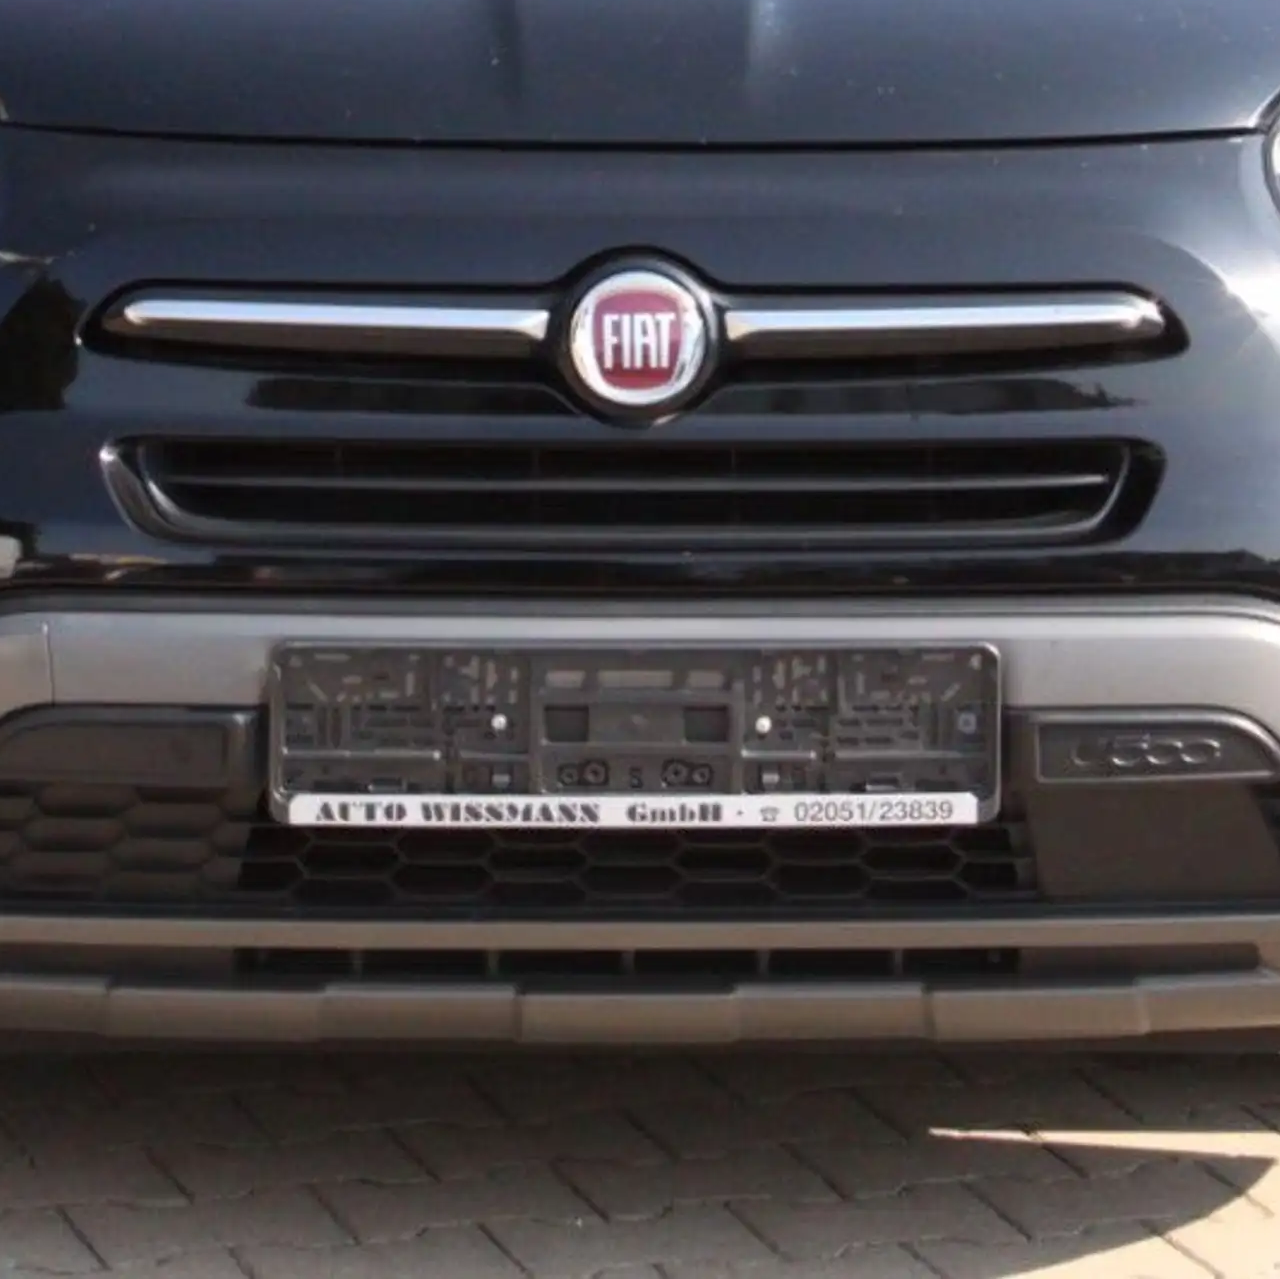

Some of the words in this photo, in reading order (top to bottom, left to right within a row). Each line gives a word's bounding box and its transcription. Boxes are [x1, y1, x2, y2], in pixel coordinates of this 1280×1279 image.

[601, 312, 676, 370] FIAT
[316, 801, 408, 822] AUTO
[419, 801, 601, 823] WISSMANN
[626, 802, 724, 823] GmbH
[793, 800, 954, 822] 02051/23839
